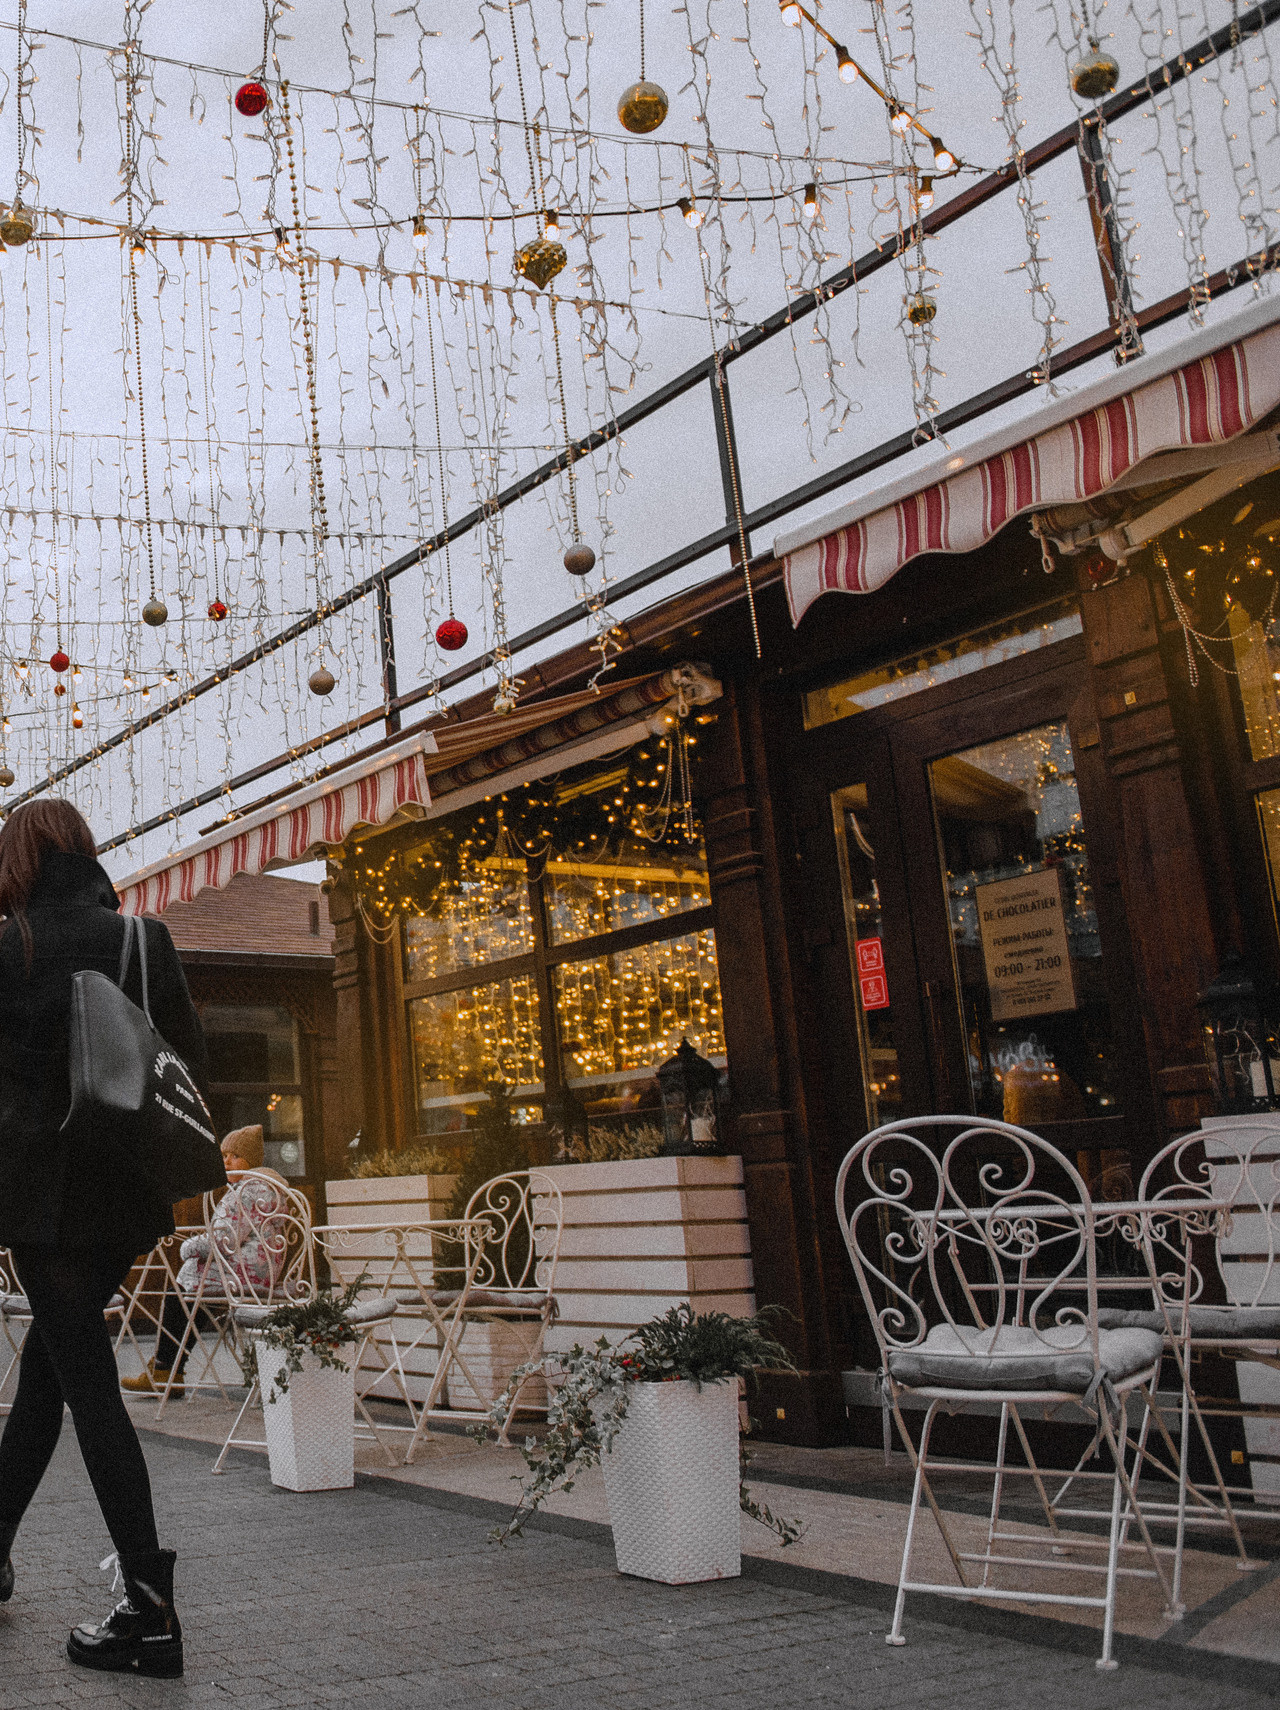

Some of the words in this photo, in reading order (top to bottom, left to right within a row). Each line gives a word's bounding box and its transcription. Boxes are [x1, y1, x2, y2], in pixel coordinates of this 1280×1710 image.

[997, 897, 1056, 919] CHOCOLATIER
[994, 962, 1024, 979] 09:00
[1035, 955, 1062, 971] 21:00
